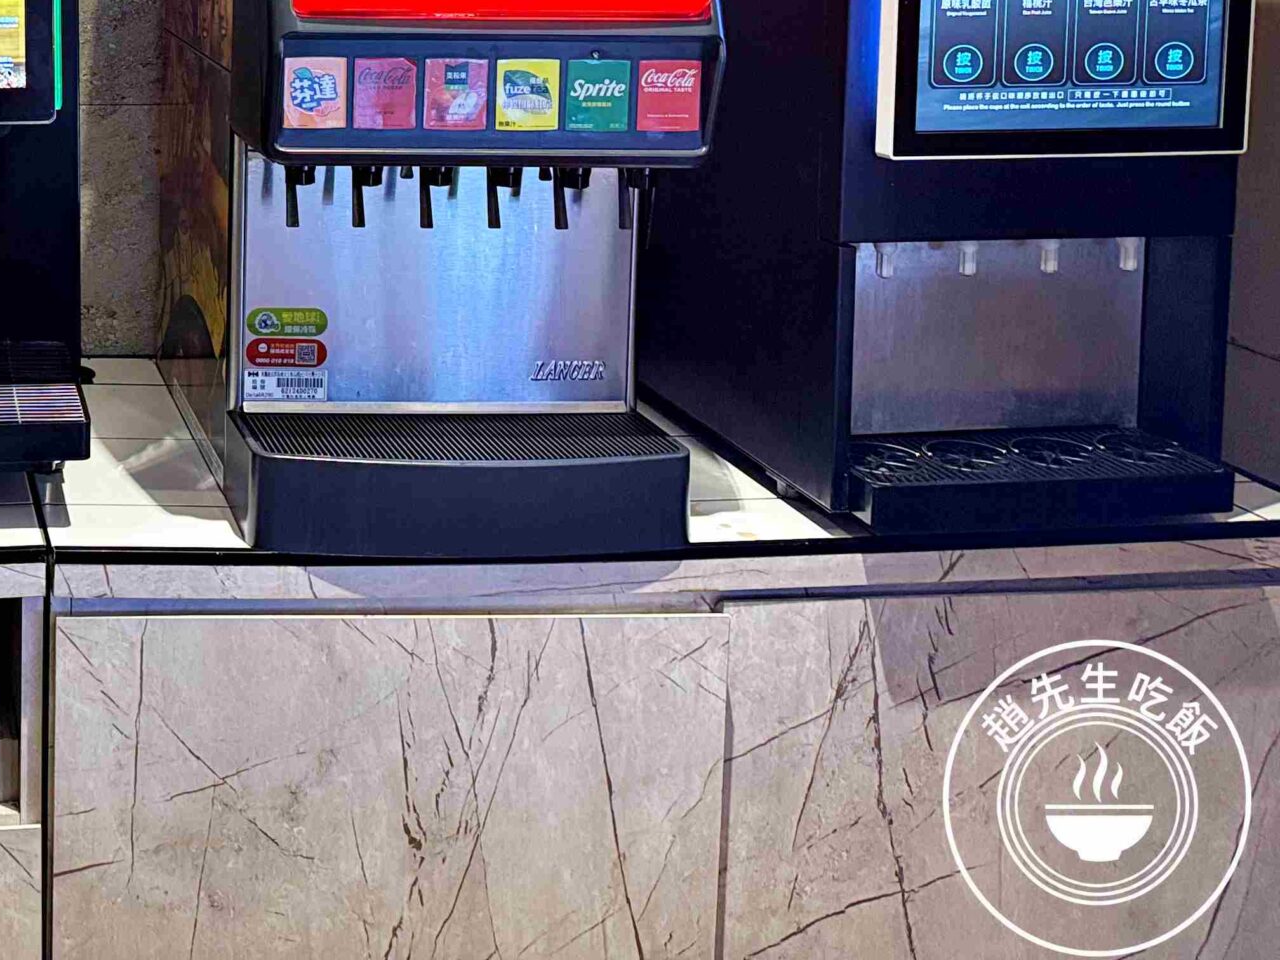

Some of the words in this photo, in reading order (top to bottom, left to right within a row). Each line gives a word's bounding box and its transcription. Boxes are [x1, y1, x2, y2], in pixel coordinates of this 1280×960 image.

[956, 52, 971, 66] 按
[1027, 51, 1042, 65] 按
[1097, 50, 1112, 64] 按
[1167, 49, 1182, 63] 按
[641, 69, 698, 87] Coca-Cola
[291, 74, 337, 105] 芬達
[570, 79, 626, 100] Sprite
[530, 360, 607, 382] LANCER
